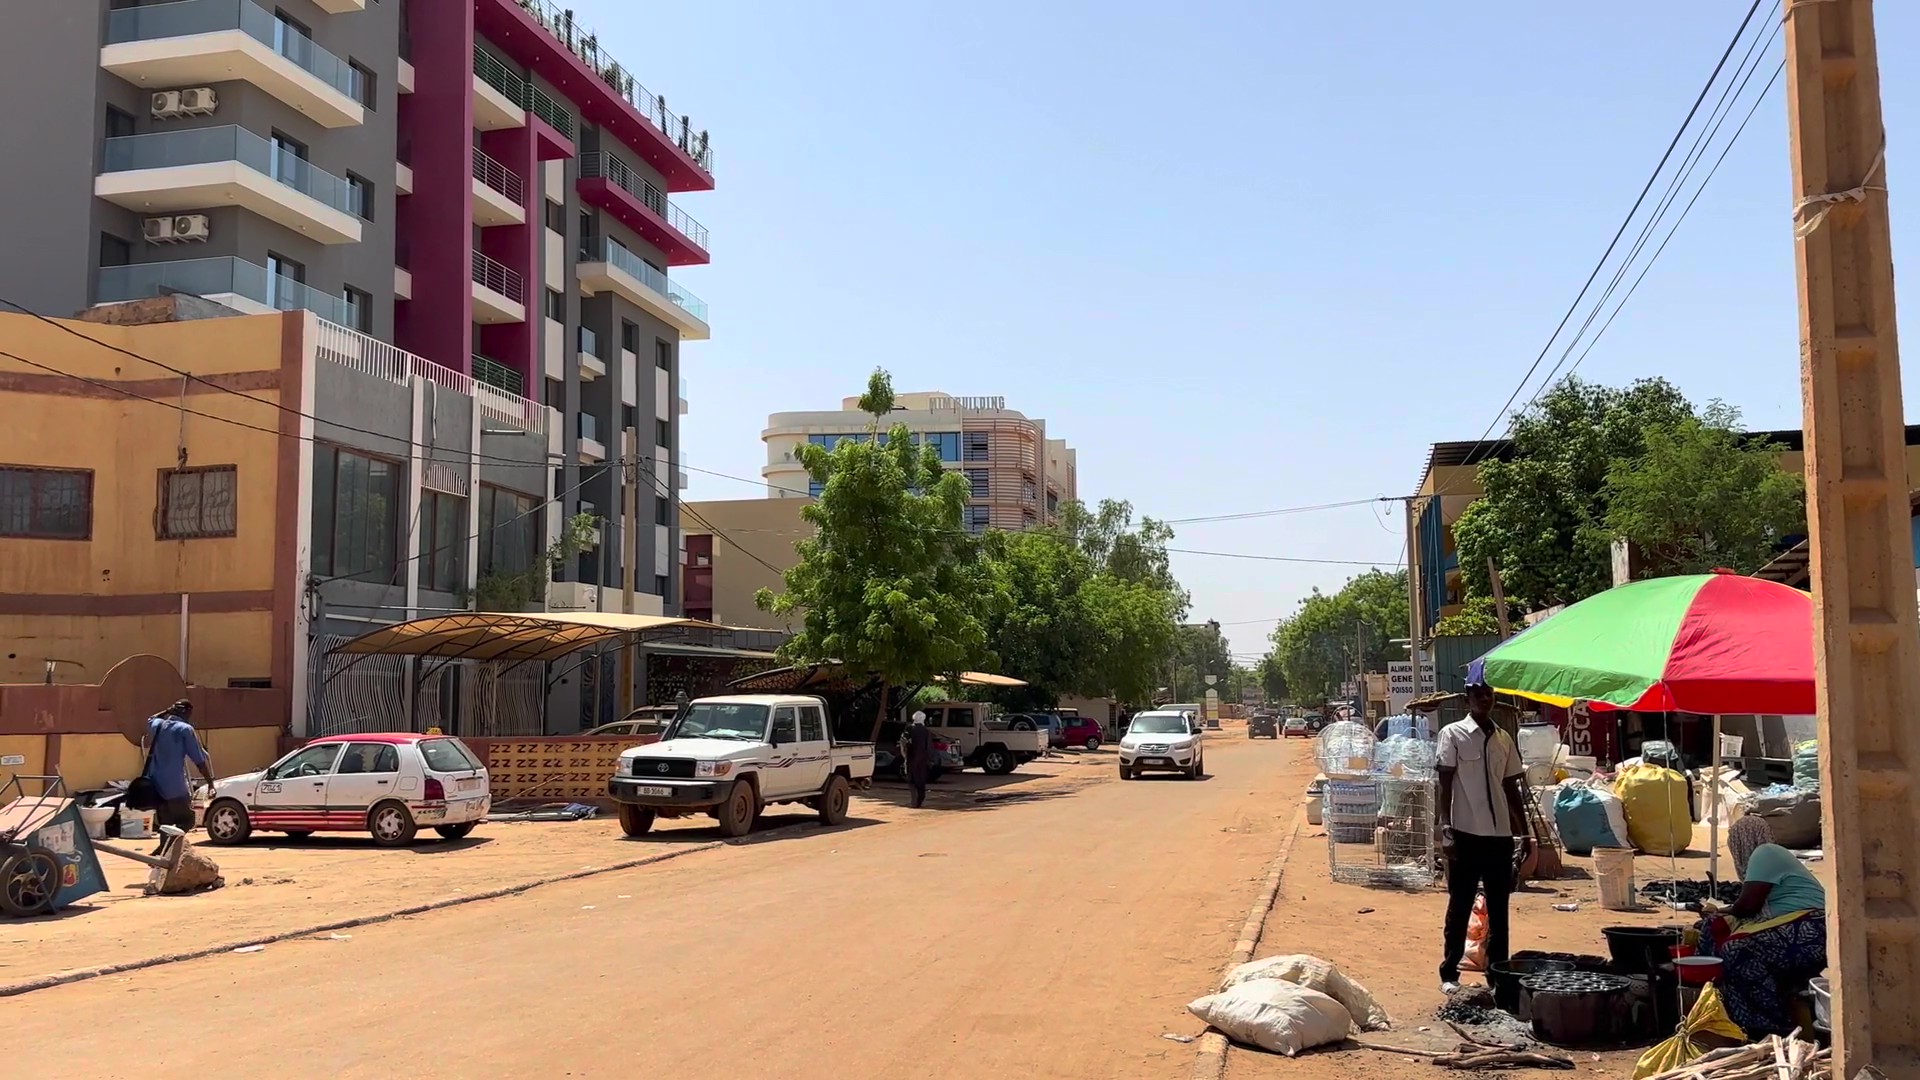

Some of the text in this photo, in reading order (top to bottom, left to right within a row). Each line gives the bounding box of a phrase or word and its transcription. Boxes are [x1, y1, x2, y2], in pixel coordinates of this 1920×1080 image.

[954, 396, 1005, 410] BUILDING
[1391, 675, 1434, 683] GENEALE
[1391, 686, 1435, 694] POISSOERIE
